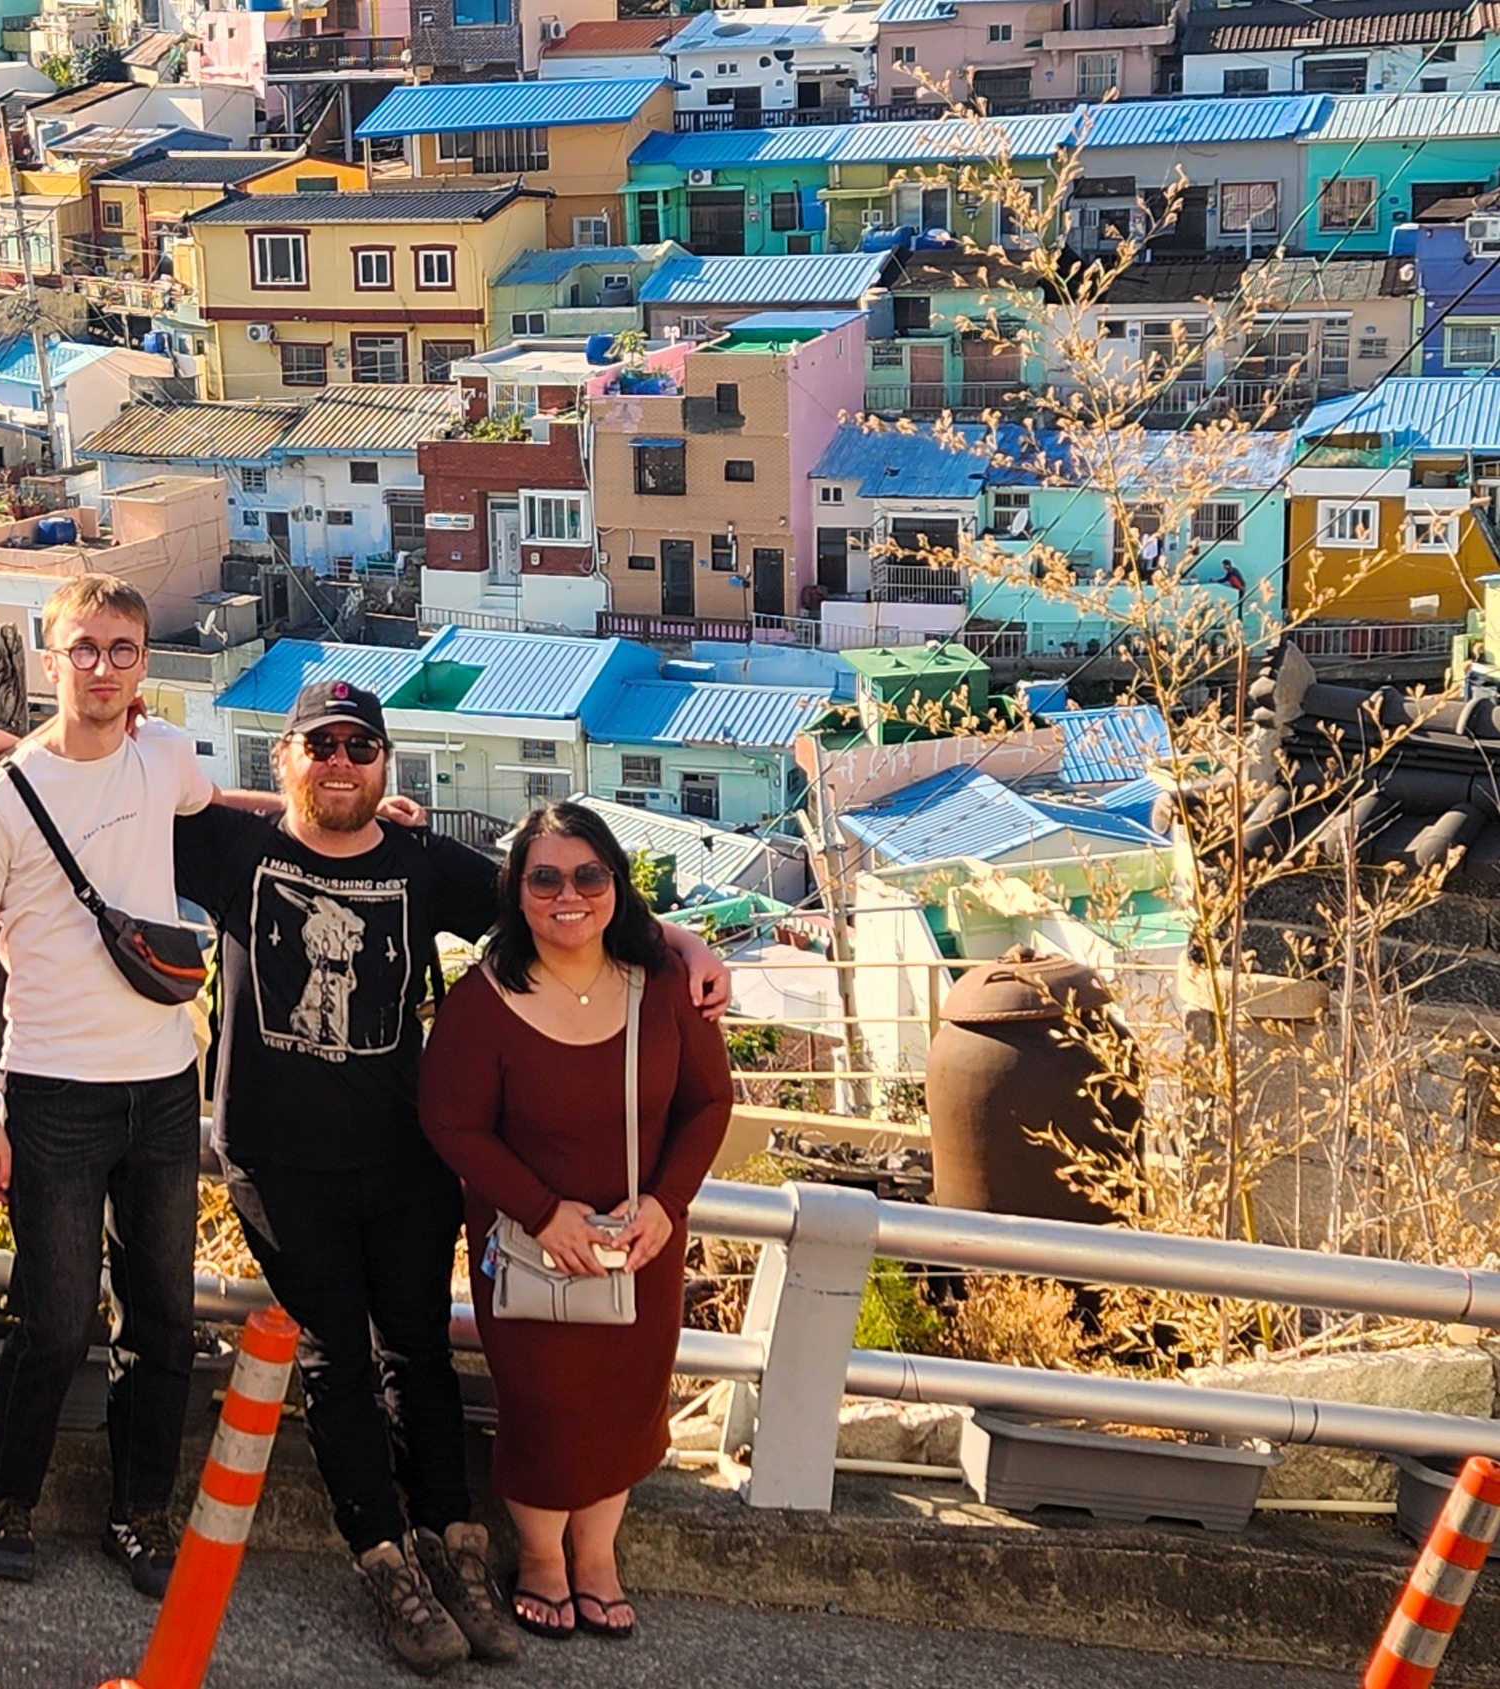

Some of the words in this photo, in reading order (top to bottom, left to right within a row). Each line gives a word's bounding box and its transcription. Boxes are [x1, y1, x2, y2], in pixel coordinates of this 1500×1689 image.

[261, 856, 268, 867] I
[269, 858, 304, 878] HAVE
[305, 873, 374, 890] CRUSHING
[375, 878, 409, 890] DEBT
[261, 1034, 293, 1053] VERY
